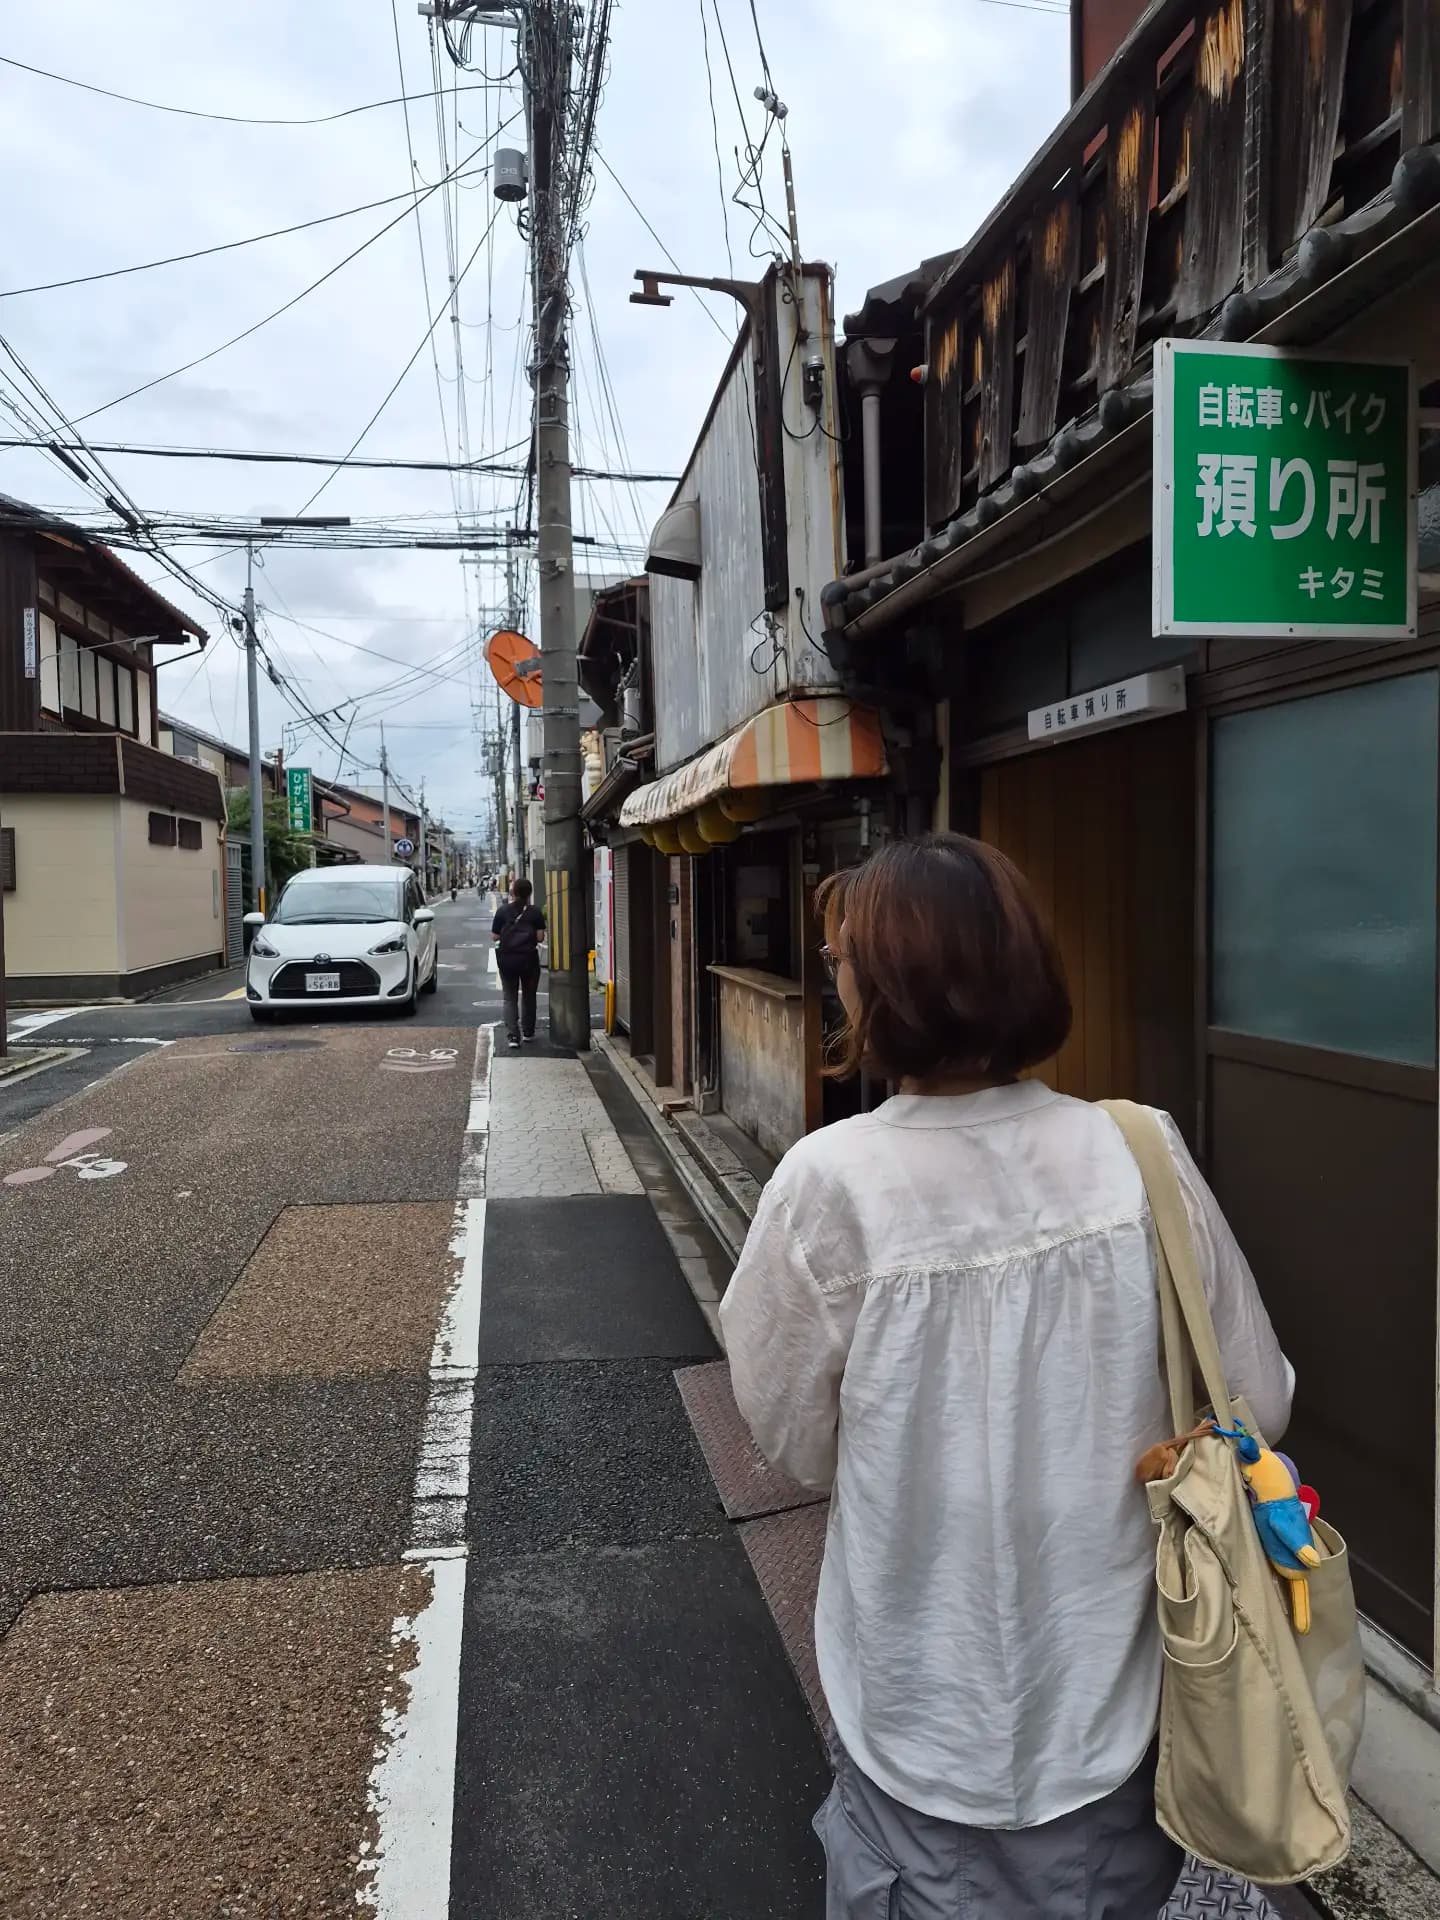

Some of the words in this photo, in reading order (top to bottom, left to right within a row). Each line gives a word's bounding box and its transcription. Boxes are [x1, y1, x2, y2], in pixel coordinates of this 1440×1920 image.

[1199, 382, 1386, 434] 自転車・バイク
[1195, 453, 1387, 544] 預り所
[1298, 566, 1384, 600] キタミ
[1044, 688, 1127, 730] 自転車預り所
